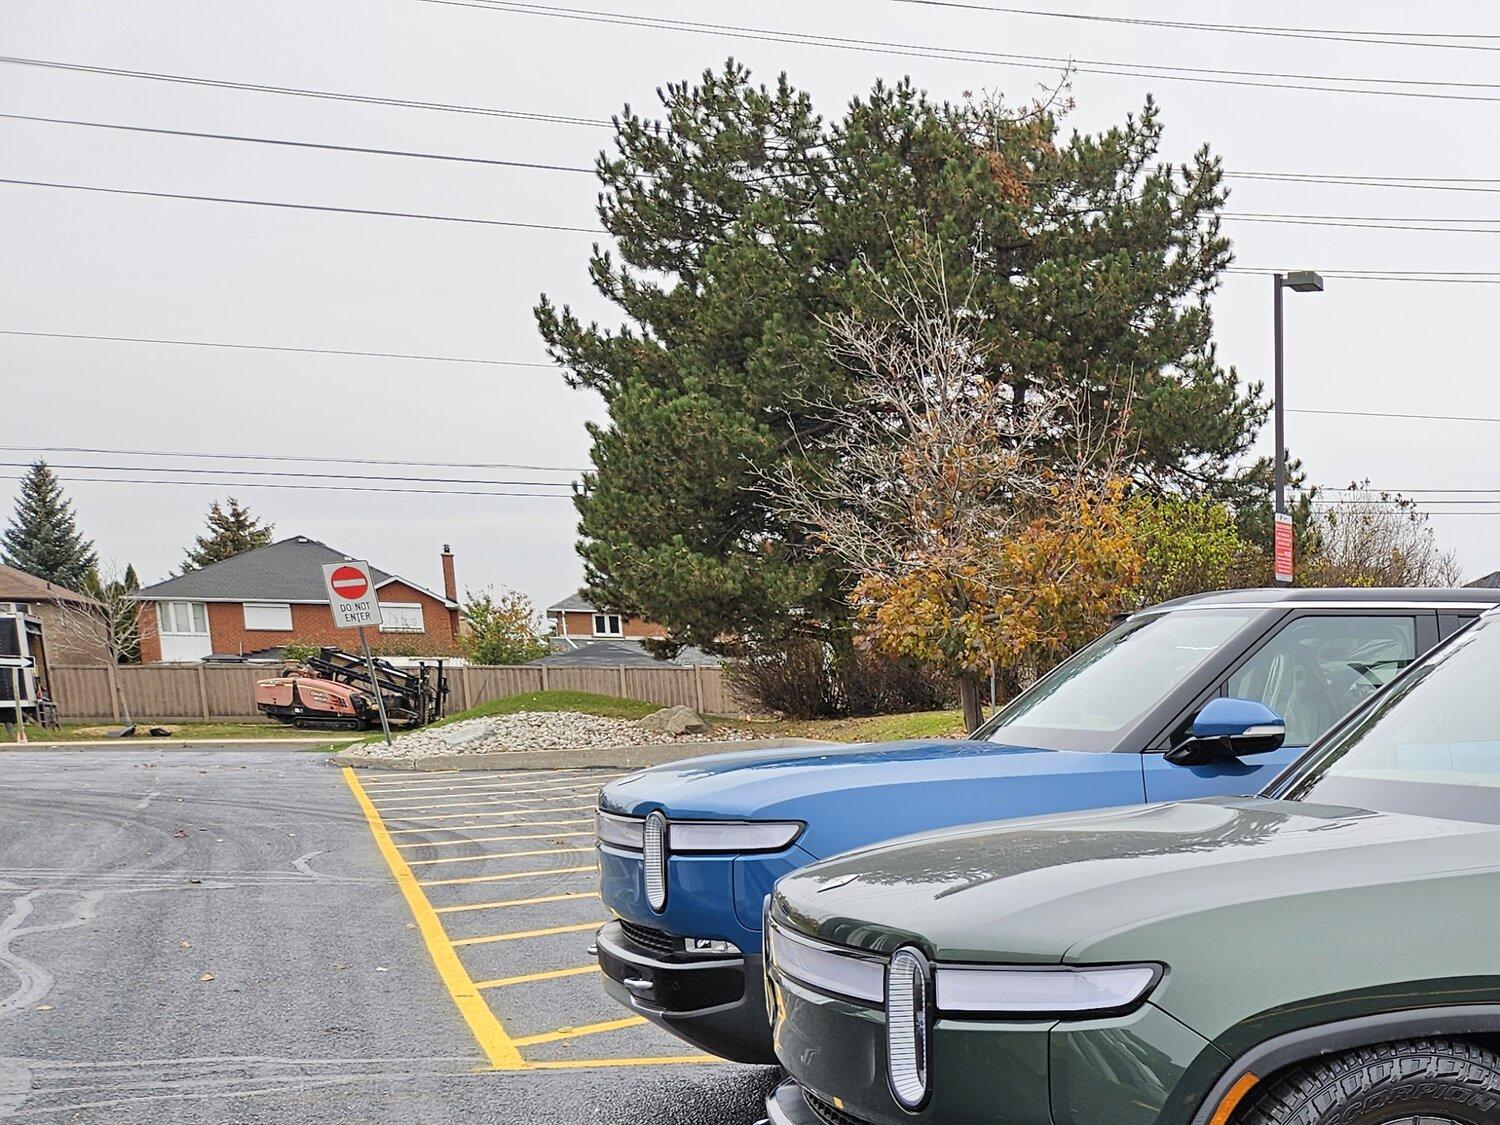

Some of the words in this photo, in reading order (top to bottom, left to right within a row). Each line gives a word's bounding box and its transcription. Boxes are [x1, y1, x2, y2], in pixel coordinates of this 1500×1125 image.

[340, 603, 352, 612] DO
[354, 601, 370, 611] NOT
[344, 612, 371, 622] ENTER
